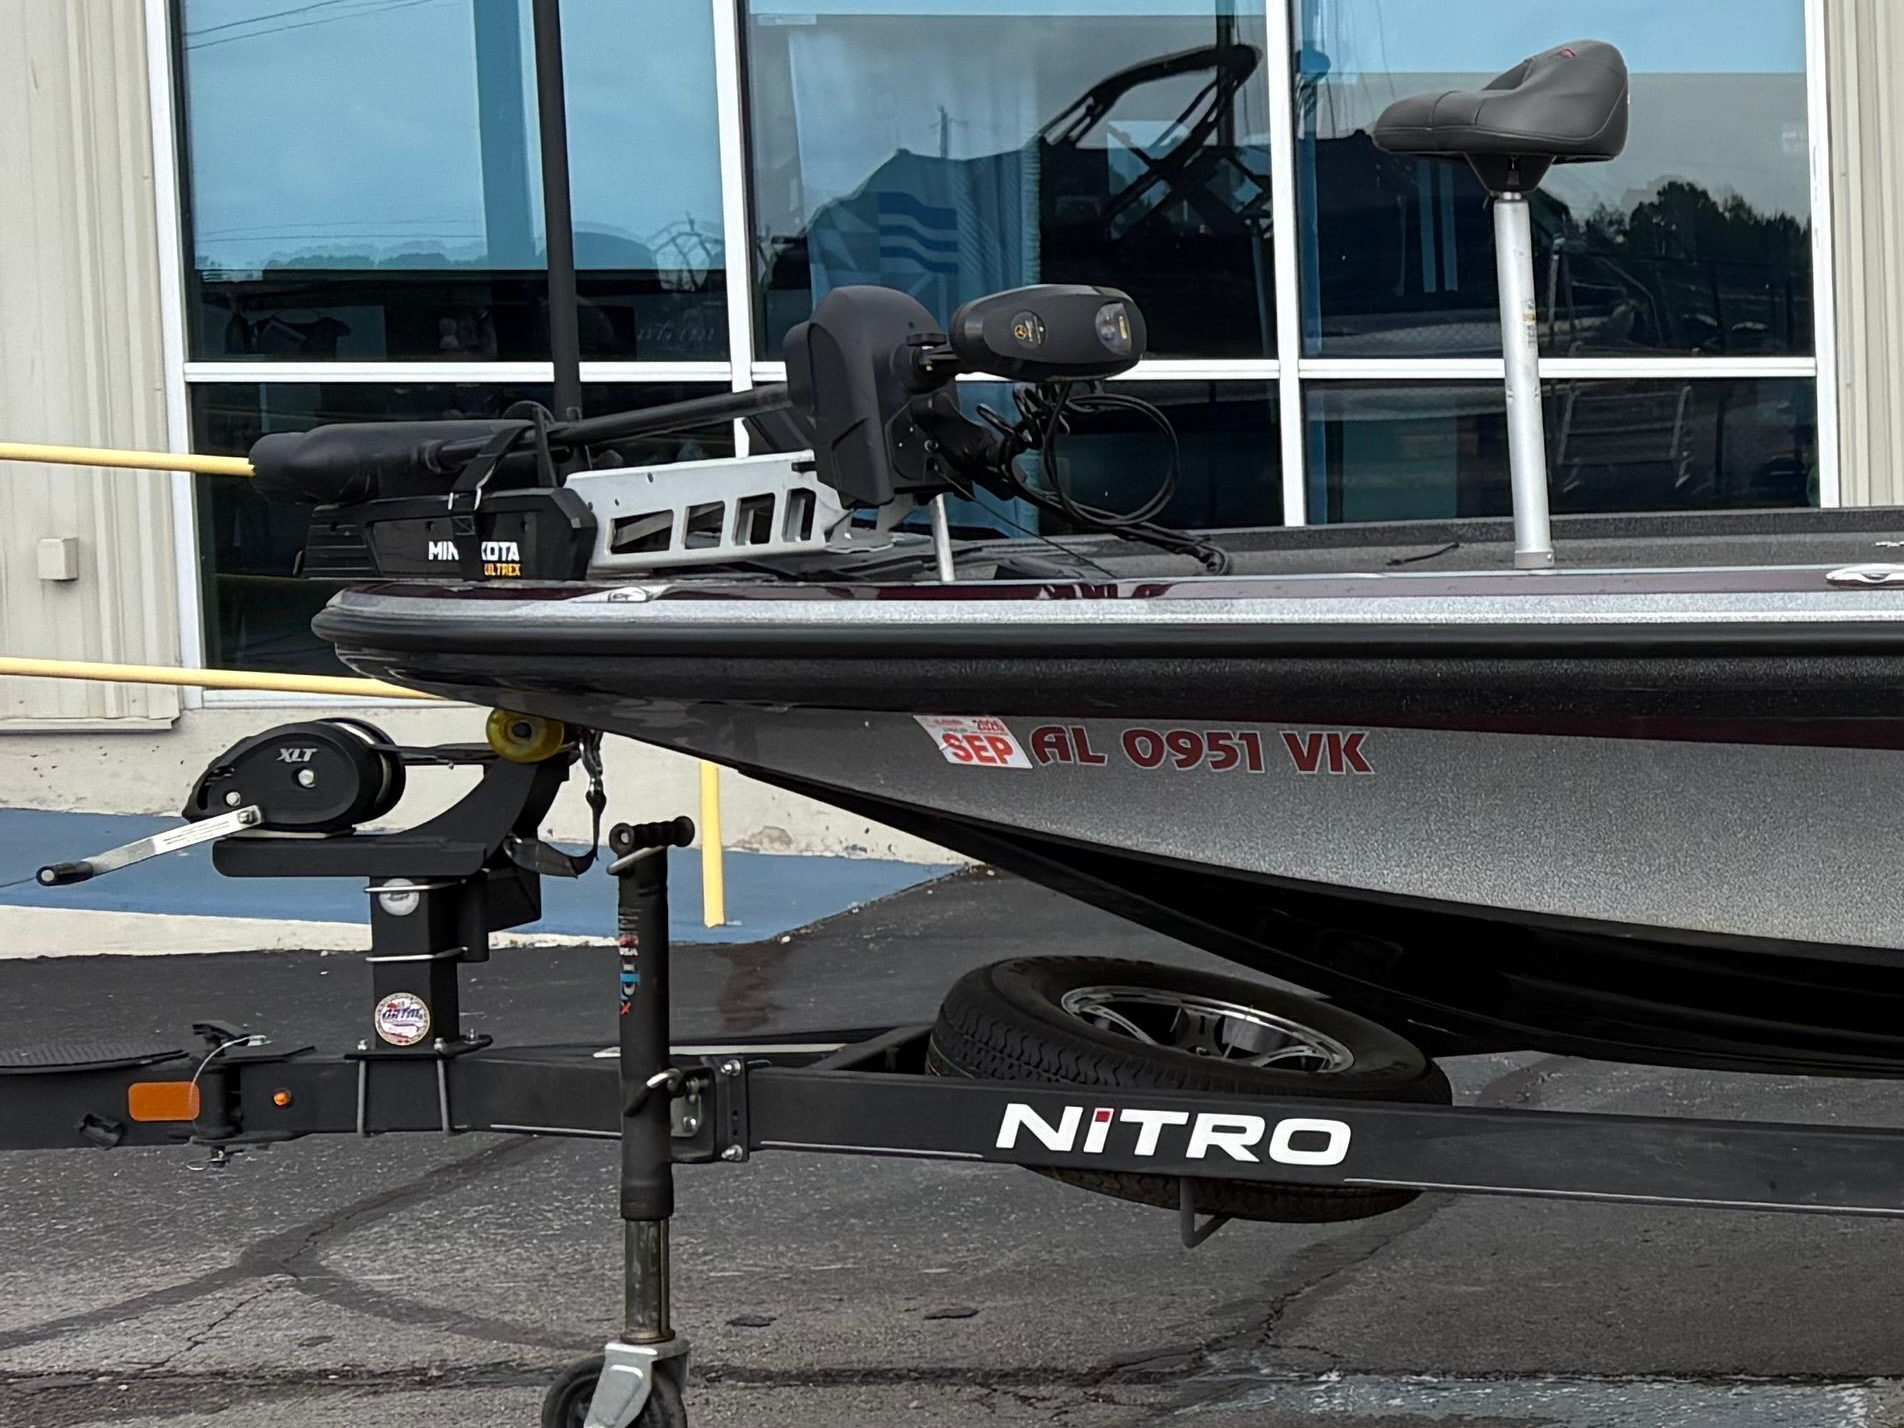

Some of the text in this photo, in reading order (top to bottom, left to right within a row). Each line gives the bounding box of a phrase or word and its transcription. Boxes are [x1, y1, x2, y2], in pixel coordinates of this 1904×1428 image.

[276, 747, 319, 763] XLT
[943, 733, 1014, 765] SEP
[1029, 726, 1376, 775] AL 0951 VK
